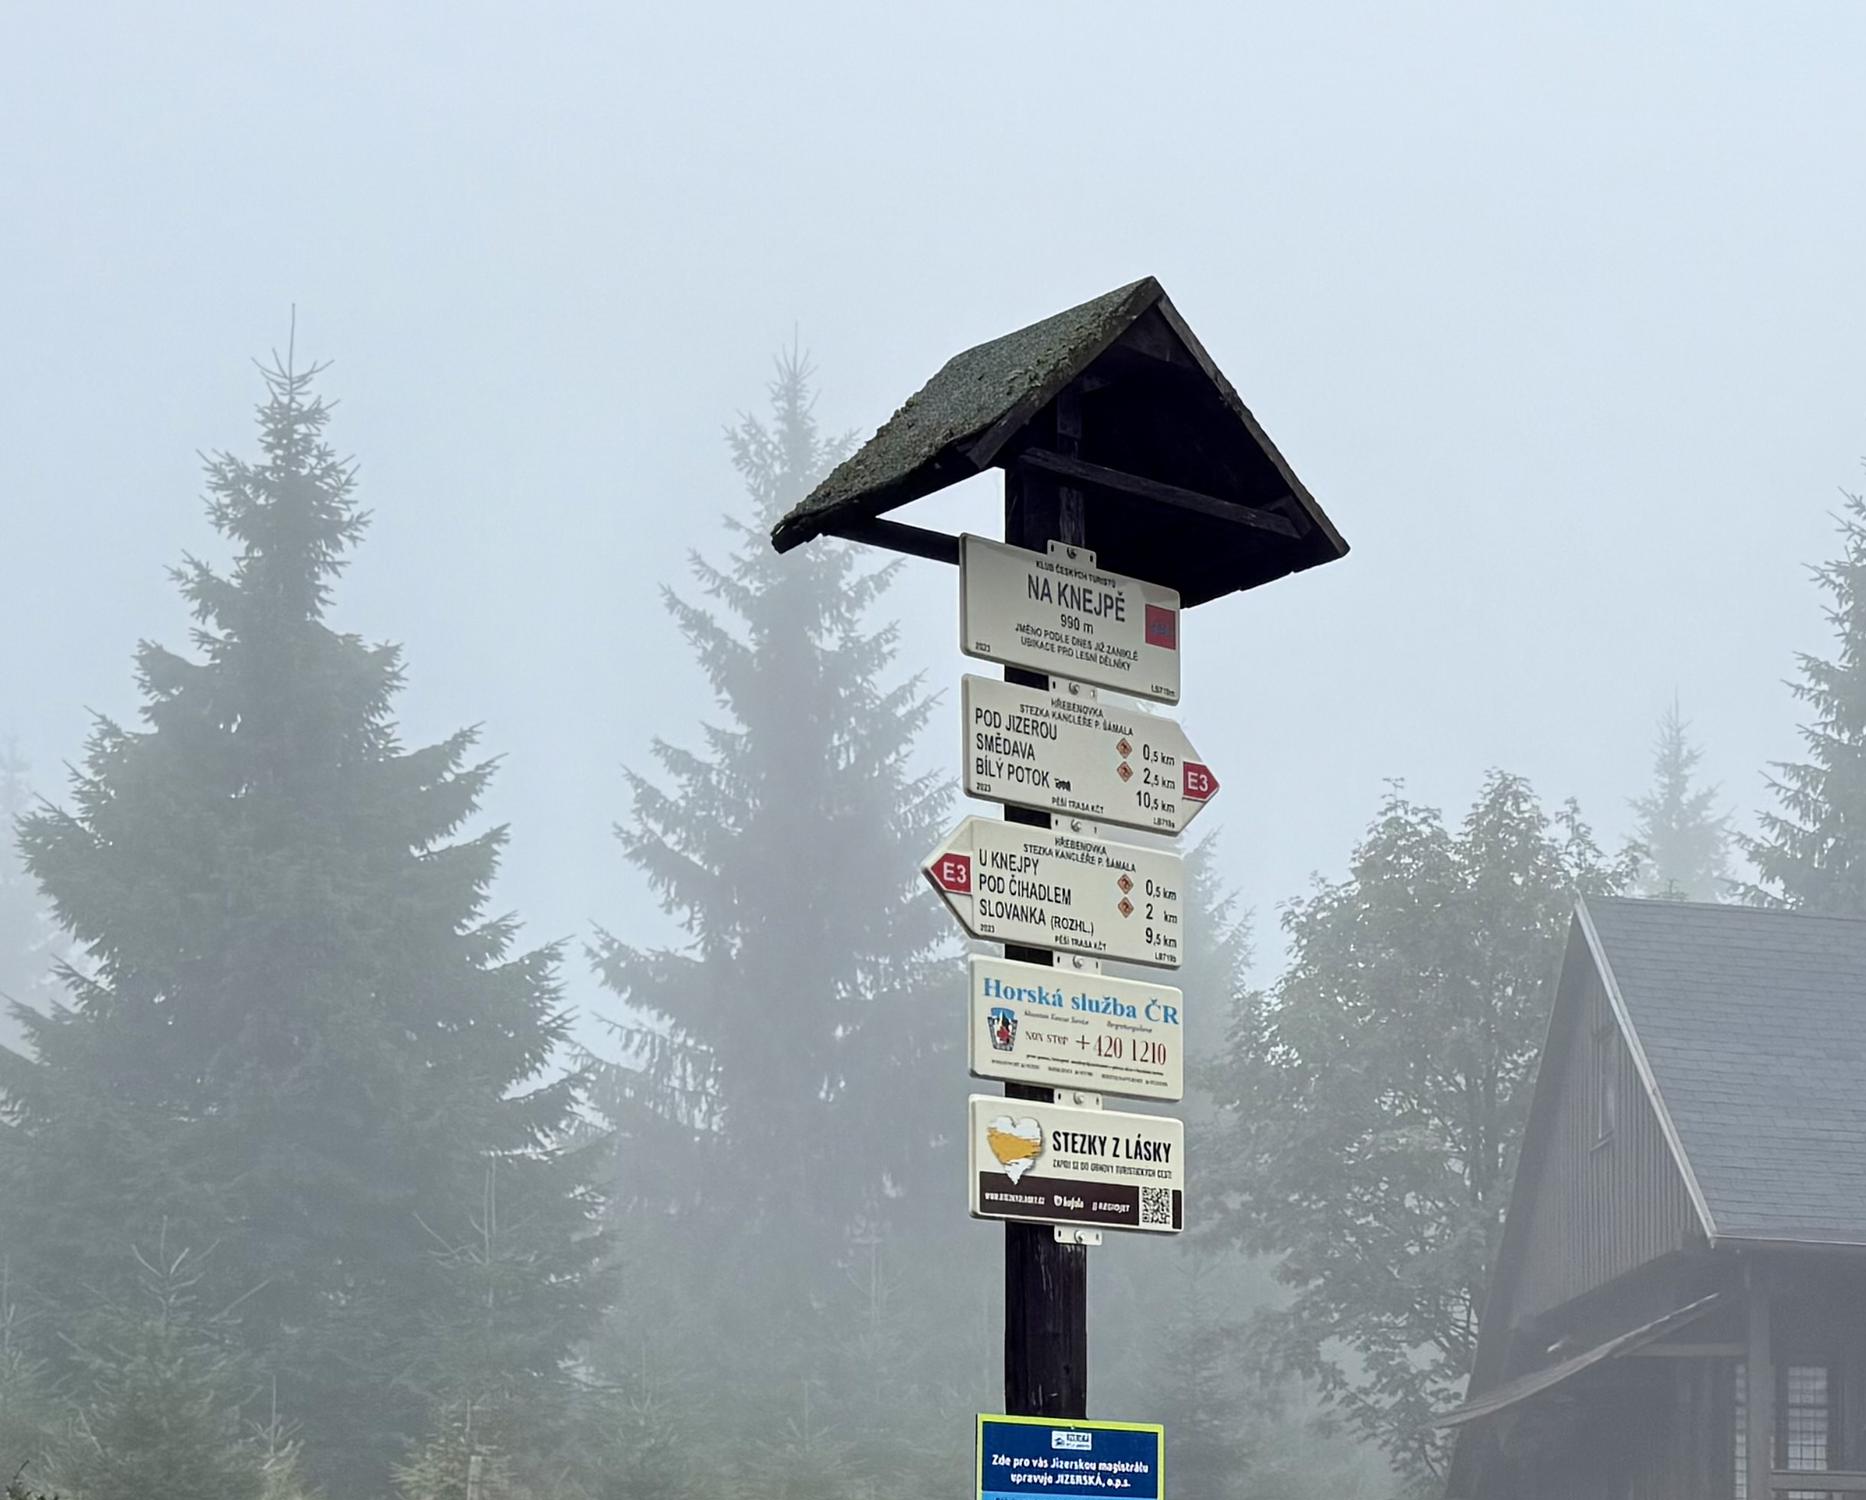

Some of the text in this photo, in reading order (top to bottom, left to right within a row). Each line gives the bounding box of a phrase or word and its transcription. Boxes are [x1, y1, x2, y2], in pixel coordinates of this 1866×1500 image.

[1027, 573, 1126, 623] NA KNEJPĚ
[1015, 623, 1042, 637] JMÉNO
[1044, 629, 1069, 644] PODLE
[1071, 636, 1092, 650] DNES
[1060, 614, 1094, 635] 990 m
[1057, 645, 1074, 657] PRO
[1020, 703, 1050, 719] STEZKA
[1103, 719, 1134, 736] ŠAMALA
[1051, 698, 1104, 718] HŘEBENOVKA
[975, 707, 1058, 741] POD JIZEROU
[976, 732, 1175, 767] SMĚDAVA 0,5 km
[976, 757, 1176, 790] BÍLÝ POTOK 2,5 km
[1187, 772, 1208, 792] E3
[976, 781, 992, 793] 2023
[1068, 800, 1090, 812] TRASA
[1136, 790, 1176, 814] 10,5 km
[1023, 843, 1054, 858] STEZKA
[1106, 856, 1137, 872] ŠAMALA
[1054, 836, 1108, 855] HŘEBENOVKA
[943, 862, 967, 883] E3
[979, 848, 1177, 901] U KNEJPY 0,5 km
[979, 873, 1178, 924] POD ČIHADLEM 2 km
[979, 898, 1177, 948] SLOVANKA (ROZHL.) 9,5 km
[979, 923, 995, 934] 2023
[1071, 938, 1092, 949] TRASA
[984, 977, 1064, 1008] Horská
[1071, 992, 1138, 1019] služba
[1144, 998, 1180, 1025] ČR
[1025, 1031, 1043, 1042] NON
[1046, 1034, 1069, 1046] STOP
[1131, 1038, 1167, 1066] 1210
[1052, 1130, 1172, 1163] STEZKY Z LÁSKY
[991, 1454, 1149, 1474] Zde pro vás Jizerskou magistrálu
[1010, 1472, 1131, 1489] upravuje JIZERSKÁ, o.p.s.
